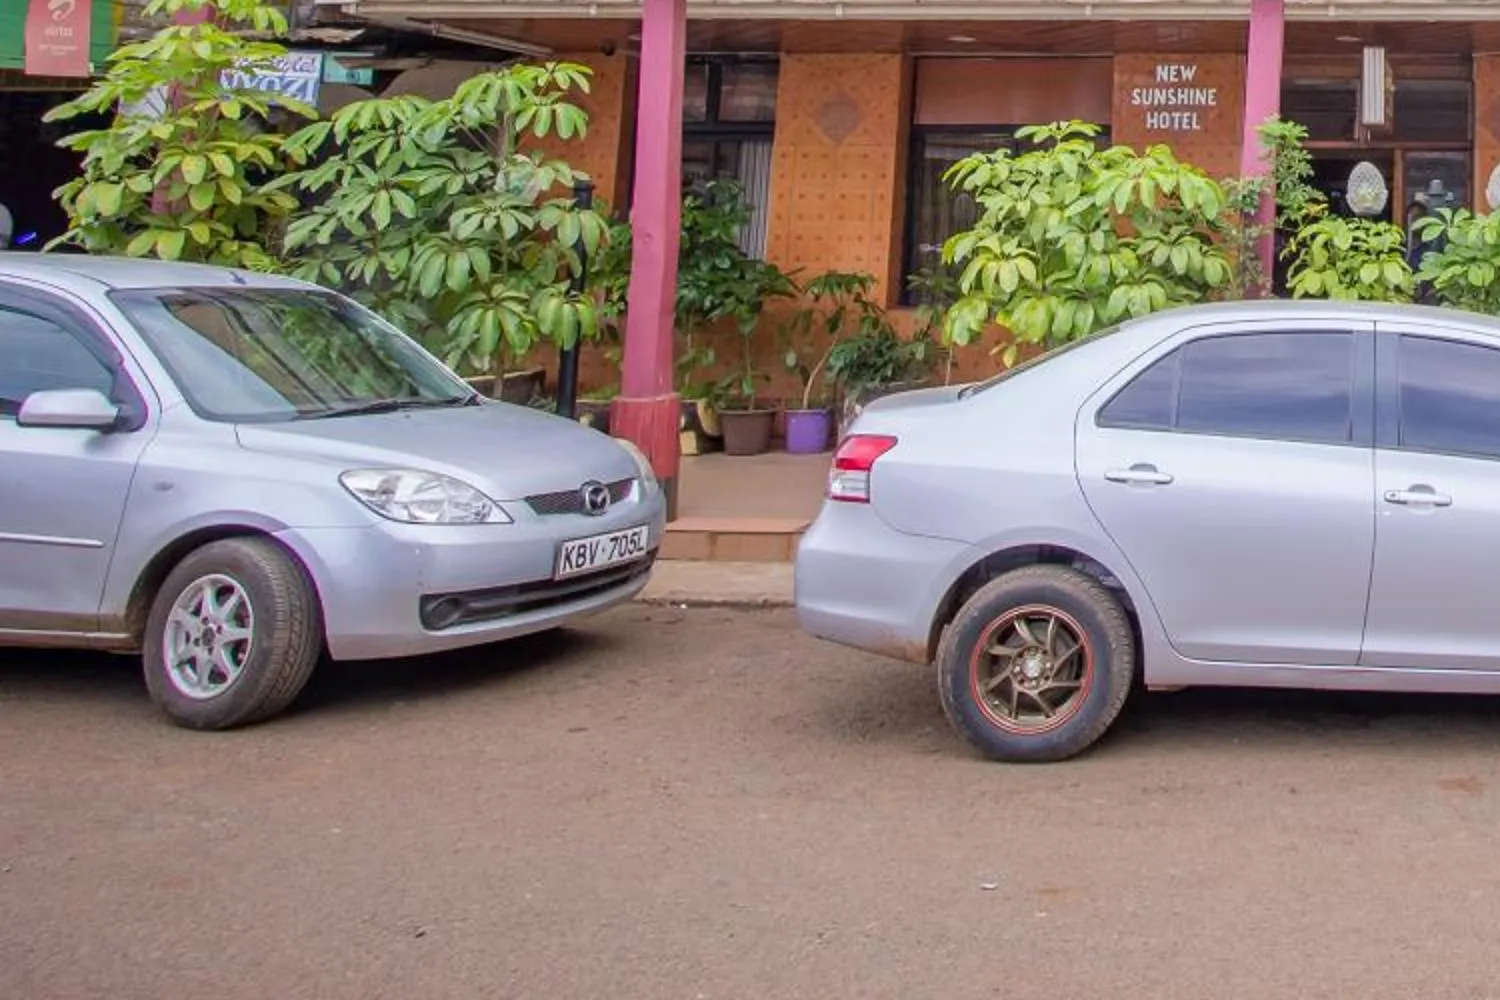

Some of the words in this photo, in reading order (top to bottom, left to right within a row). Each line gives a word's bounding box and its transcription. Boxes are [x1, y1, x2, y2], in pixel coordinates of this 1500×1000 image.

[1156, 65, 1197, 82] NEW
[1131, 88, 1217, 106] SUNSHINE
[1146, 111, 1200, 130] HOTEL
[561, 540, 600, 572] KBV
[608, 530, 645, 560] 705L
